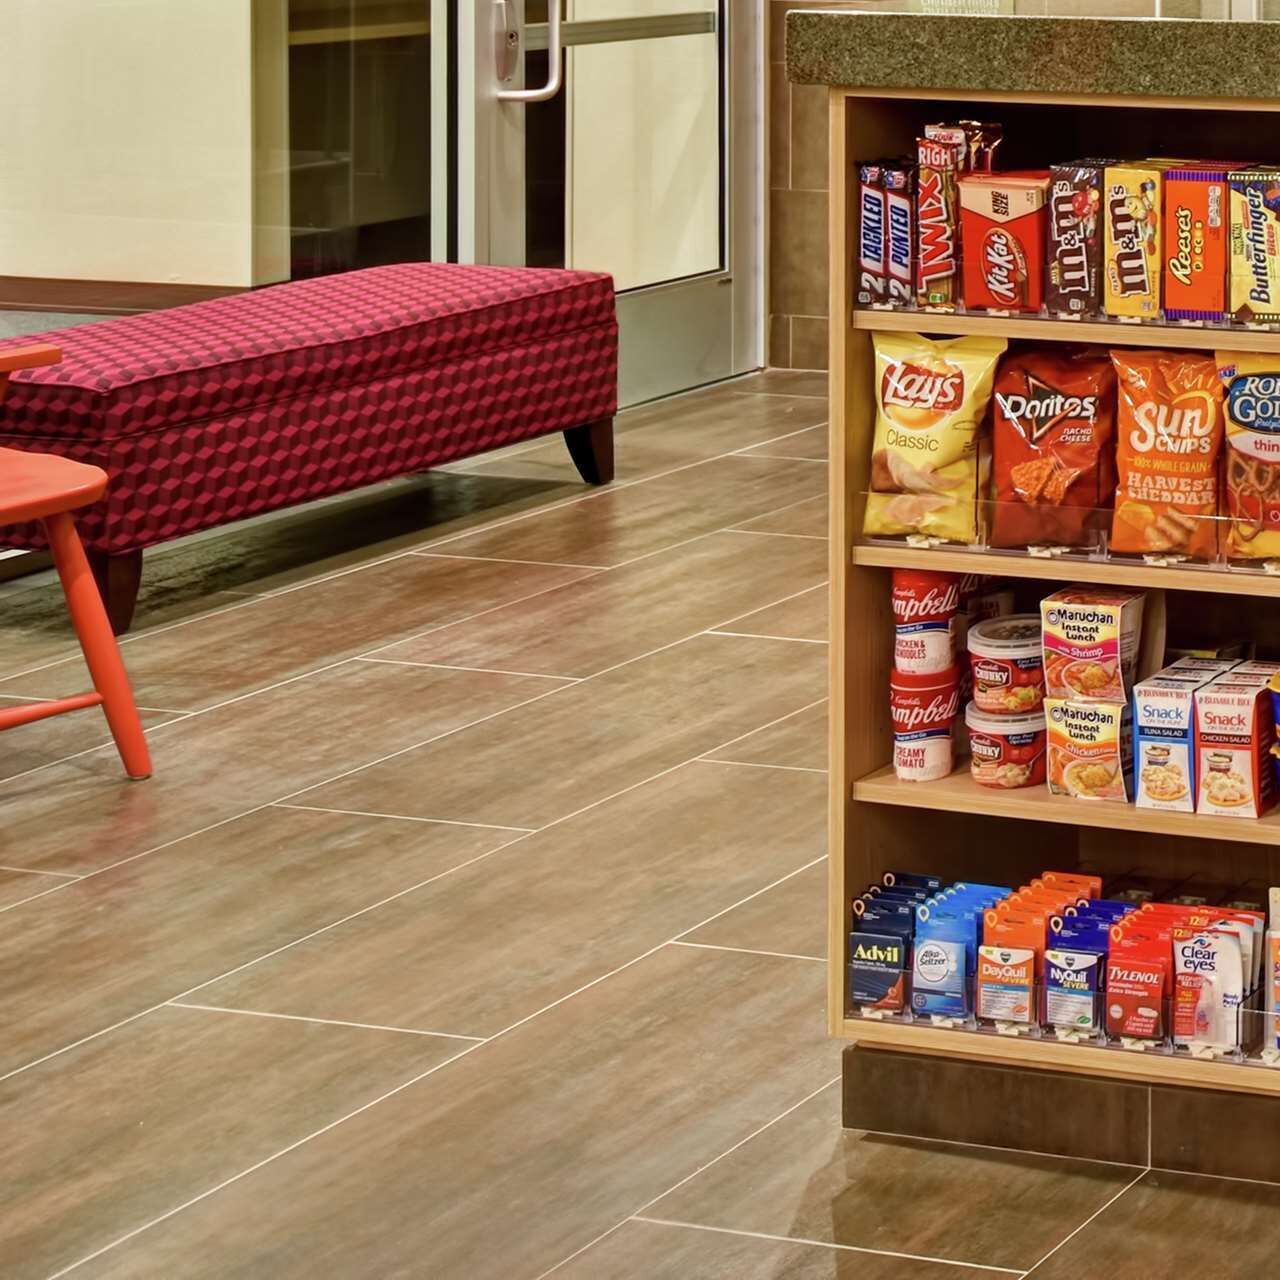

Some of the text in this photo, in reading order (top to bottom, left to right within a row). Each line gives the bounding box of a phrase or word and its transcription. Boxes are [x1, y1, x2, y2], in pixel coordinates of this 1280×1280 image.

[1247, 187, 1271, 304] Butterfinger
[1004, 395, 1096, 418] Doritos
[887, 429, 939, 451] Classic
[1060, 434, 1092, 442] CHEESE
[1128, 472, 1215, 490] HARVEST
[1129, 488, 1215, 505] CHEDDAR
[1057, 609, 1114, 624] Maruchan
[1061, 623, 1099, 634] Instant
[1066, 632, 1096, 642] Lunch
[1070, 647, 1104, 659] Shrimp
[1060, 708, 1114, 725] Maruchan
[1143, 705, 1184, 720] Snack
[1204, 711, 1246, 726] Snack
[1065, 721, 1100, 734] Instant
[1162, 729, 1183, 737] SALAD
[1068, 731, 1097, 742] Lunch
[1201, 735, 1250, 744] CHICKEN SALAD
[853, 945, 898, 963] Advil
[1182, 946, 1217, 960] Clear
[919, 956, 946, 966] Seltzer
[1184, 959, 1216, 972] eyes
[982, 964, 1026, 978] DayQuil
[1051, 968, 1087, 983] NyQuil
[1109, 967, 1159, 984] TYLENOL
